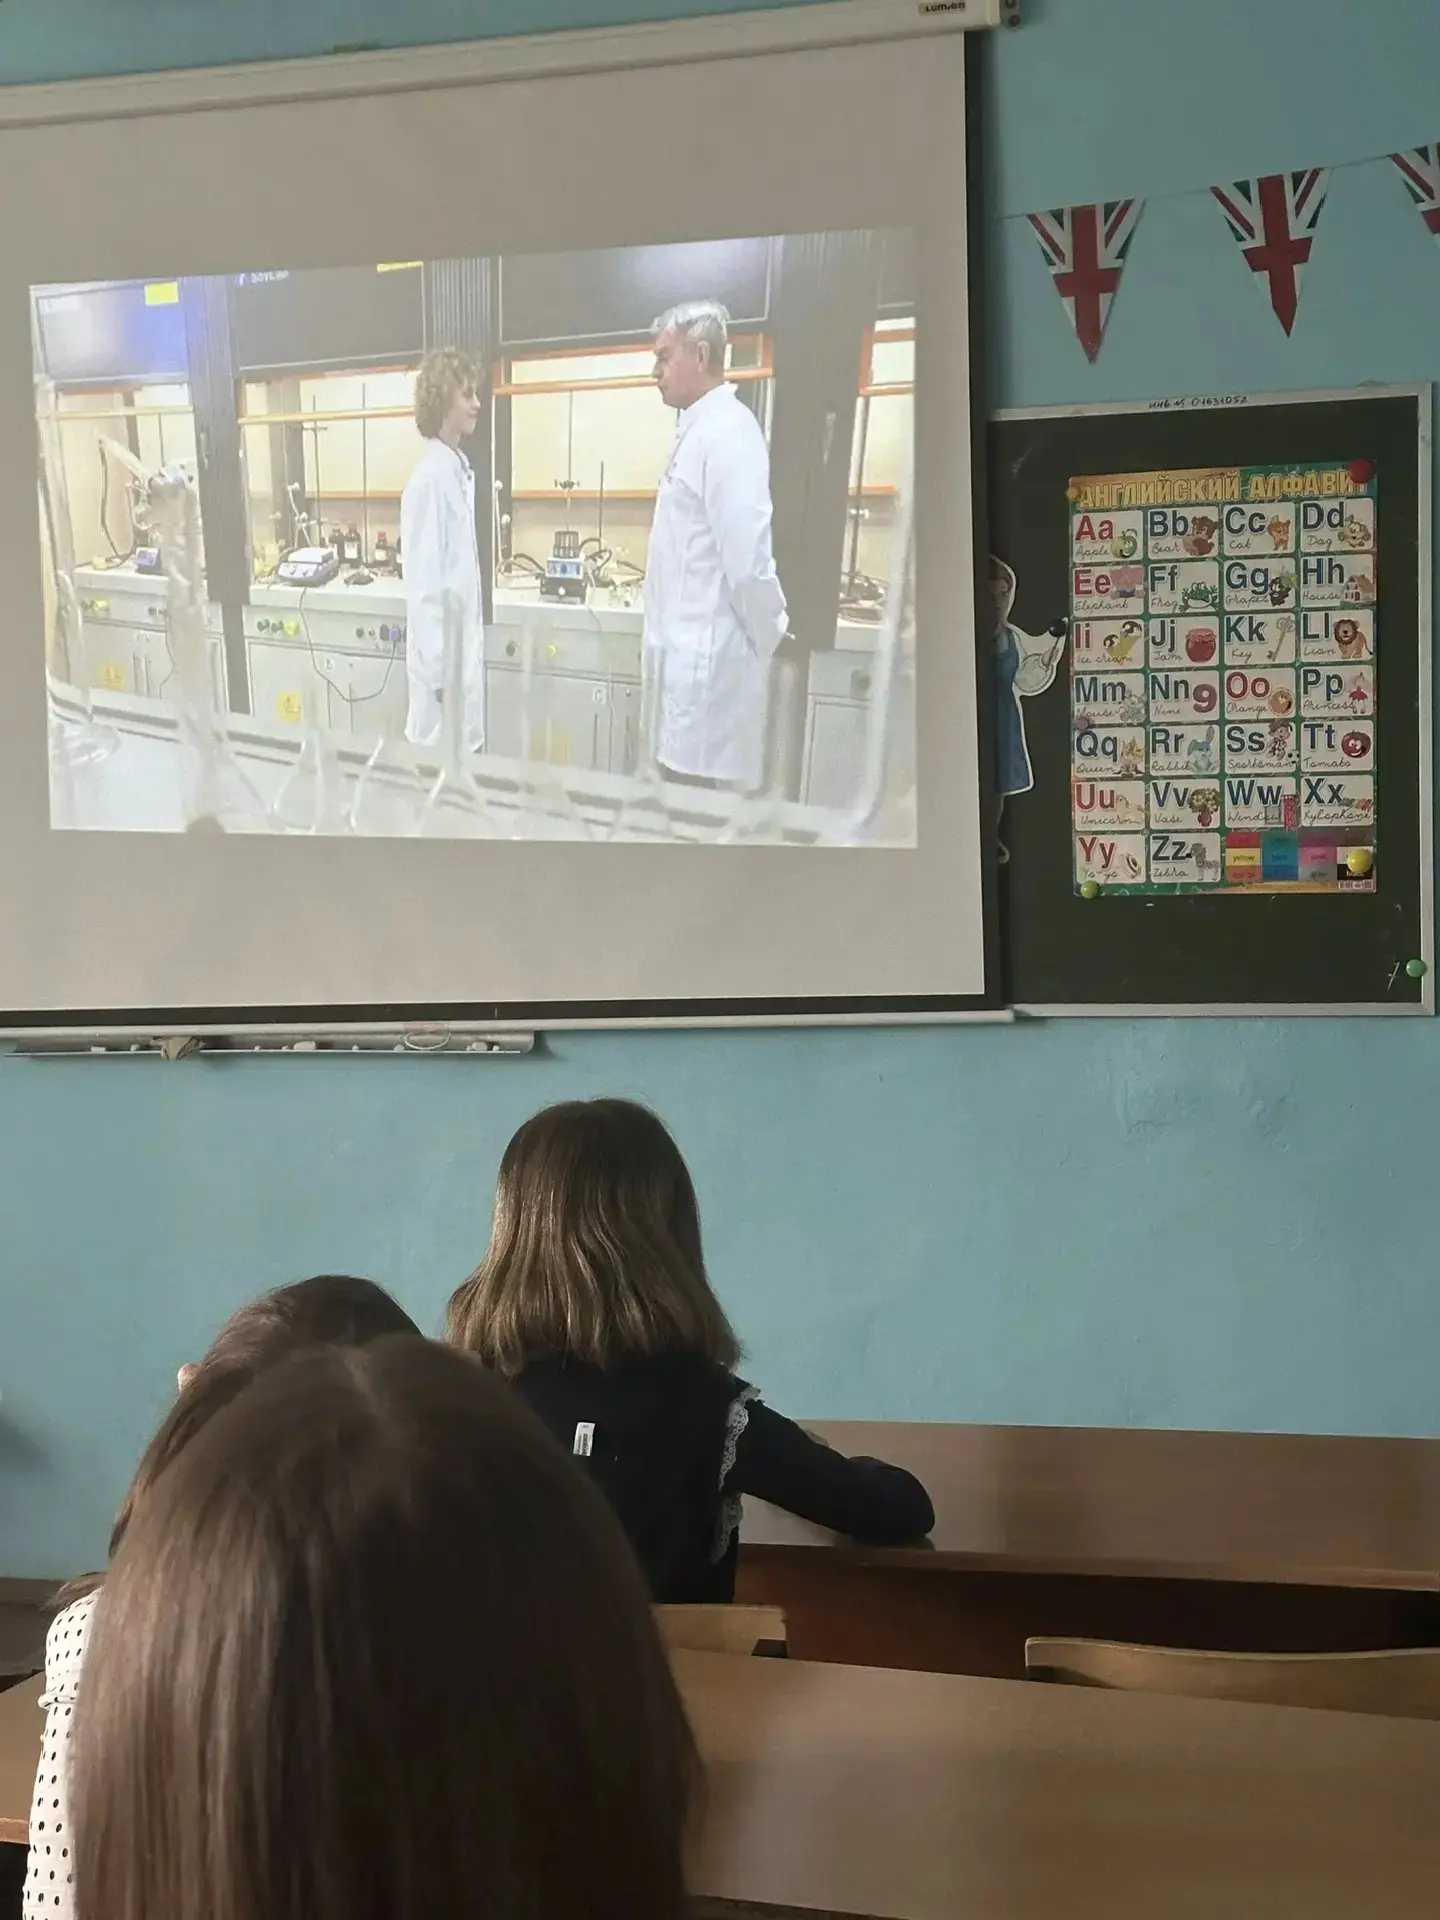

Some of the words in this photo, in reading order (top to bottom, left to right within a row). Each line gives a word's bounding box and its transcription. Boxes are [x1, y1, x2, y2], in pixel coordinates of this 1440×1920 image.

[1079, 472, 1240, 509] АНГЛИЙСКИЙ
[1075, 515, 1114, 541] Aa
[1149, 510, 1189, 537] Bb
[1225, 506, 1266, 534] Cc
[1302, 501, 1344, 530] Dd
[1306, 534, 1333, 552] Dog
[1074, 568, 1112, 596] Ee
[1150, 564, 1178, 592] Ff
[1225, 561, 1269, 596] Gg
[1302, 557, 1344, 586] Hh
[1074, 599, 1129, 614] Elephant
[1302, 590, 1340, 601] House
[1151, 618, 1176, 654] Jj
[1225, 615, 1267, 643] Kk
[1302, 612, 1330, 640] Ll
[1231, 648, 1253, 664] Key
[1075, 676, 1127, 702] Mm
[1150, 673, 1190, 700] Nn
[1225, 671, 1270, 699] Oo
[1302, 668, 1344, 702] Pp
[1076, 730, 1118, 763] Qq
[1151, 728, 1185, 754] Rr
[1226, 725, 1266, 753] Ss
[1303, 723, 1336, 750] Tt
[1076, 762, 1115, 774] Queen
[1303, 757, 1352, 769] Tomato
[1076, 783, 1115, 810] Uu
[1151, 781, 1189, 808] Vv
[1226, 779, 1282, 806] Ww
[1304, 777, 1344, 805] Xx
[1078, 836, 1116, 869] Yy
[1152, 835, 1187, 861] Zz
[1232, 853, 1256, 863] yellow
[1152, 867, 1189, 878] Zebra
